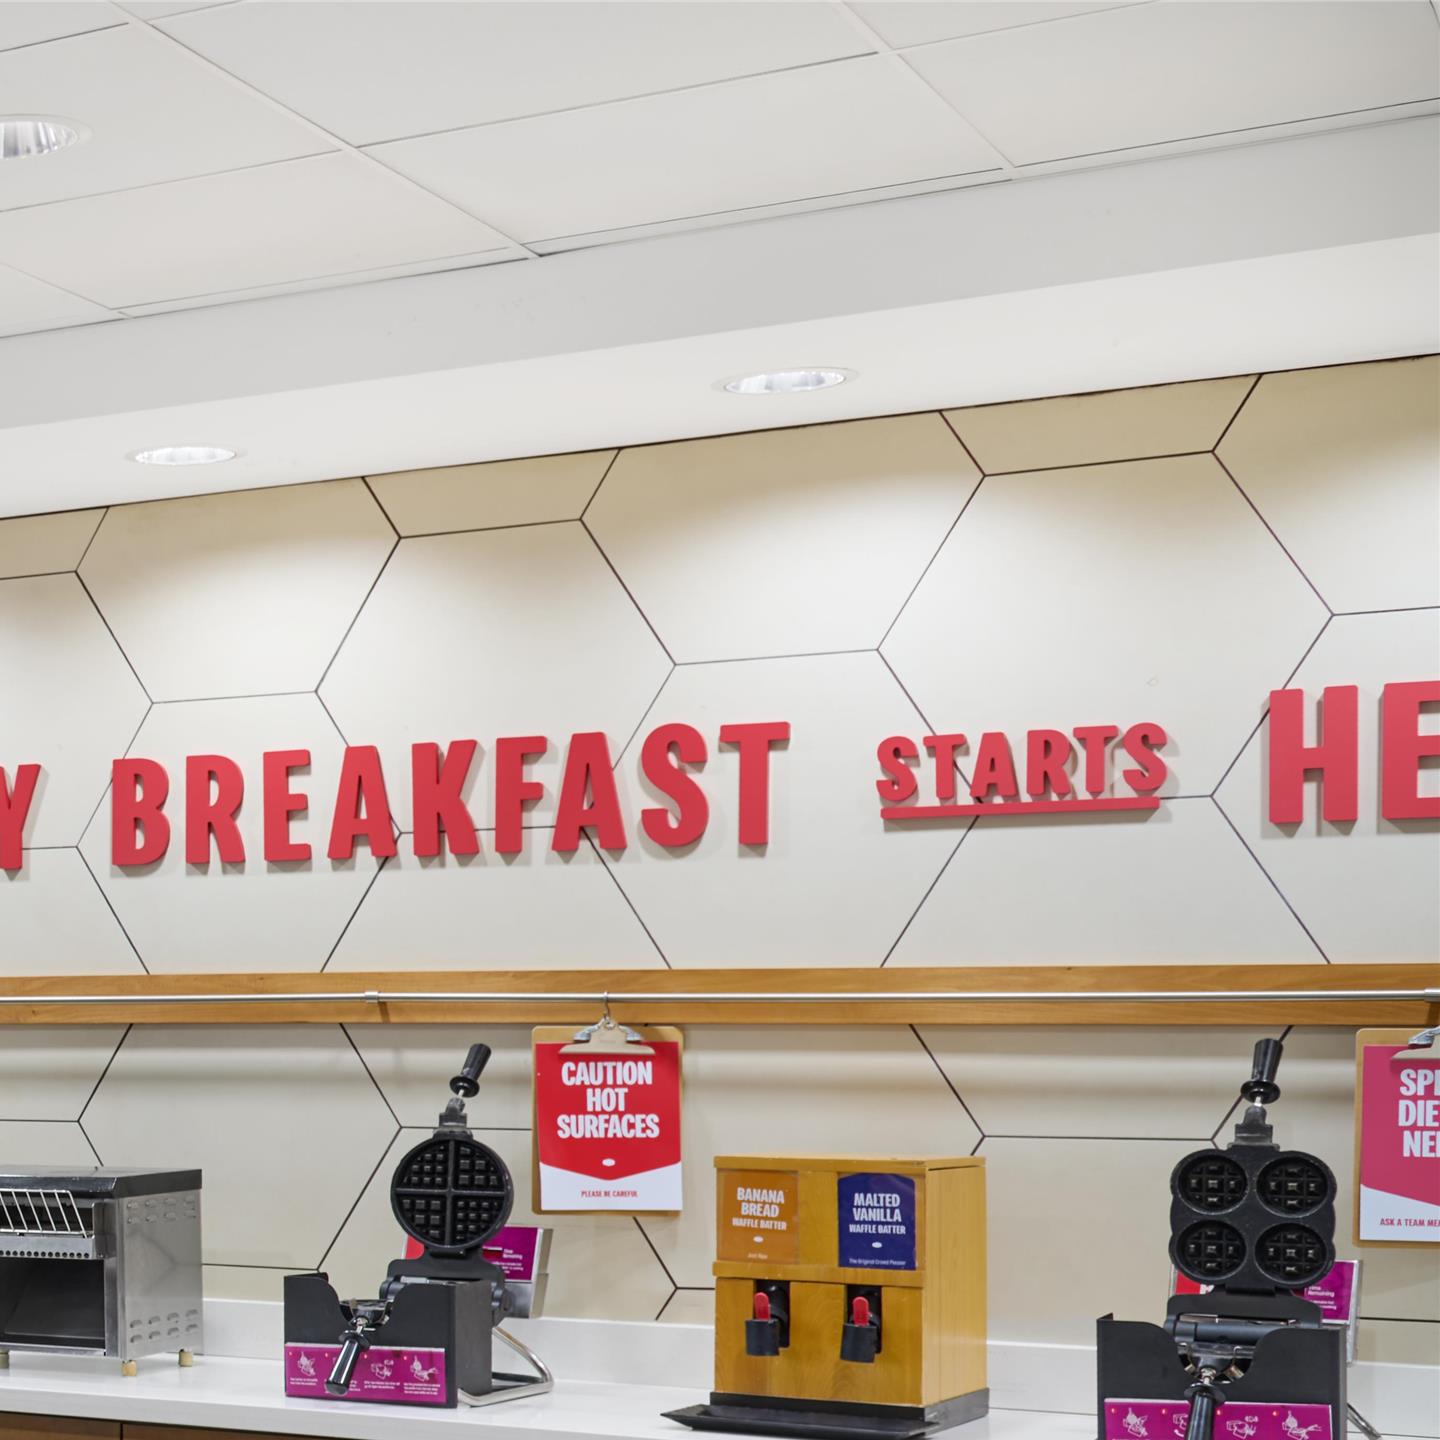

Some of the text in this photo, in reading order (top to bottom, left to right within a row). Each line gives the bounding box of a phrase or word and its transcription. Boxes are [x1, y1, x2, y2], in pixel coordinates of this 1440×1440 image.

[112, 722, 790, 867] BREAKFAST
[876, 722, 1168, 801] STARTS
[561, 1061, 653, 1086] CAUTION
[586, 1087, 629, 1112] HOT
[556, 1114, 660, 1139] SURFACES
[1402, 1130, 1440, 1158] NE
[581, 1190, 602, 1198] PLEASE
[604, 1190, 611, 1198] BE
[736, 1187, 785, 1204] BANANA
[853, 1192, 901, 1208] MALTED
[741, 1202, 780, 1218] BREAD
[852, 1207, 902, 1222] VANILLA
[732, 1217, 787, 1231] WAFFLE BATTER
[848, 1224, 906, 1235] WAFFLE BATTER
[1380, 1218, 1395, 1226] ASK
[1397, 1218, 1403, 1226] A
[1405, 1218, 1425, 1227] TEAM
